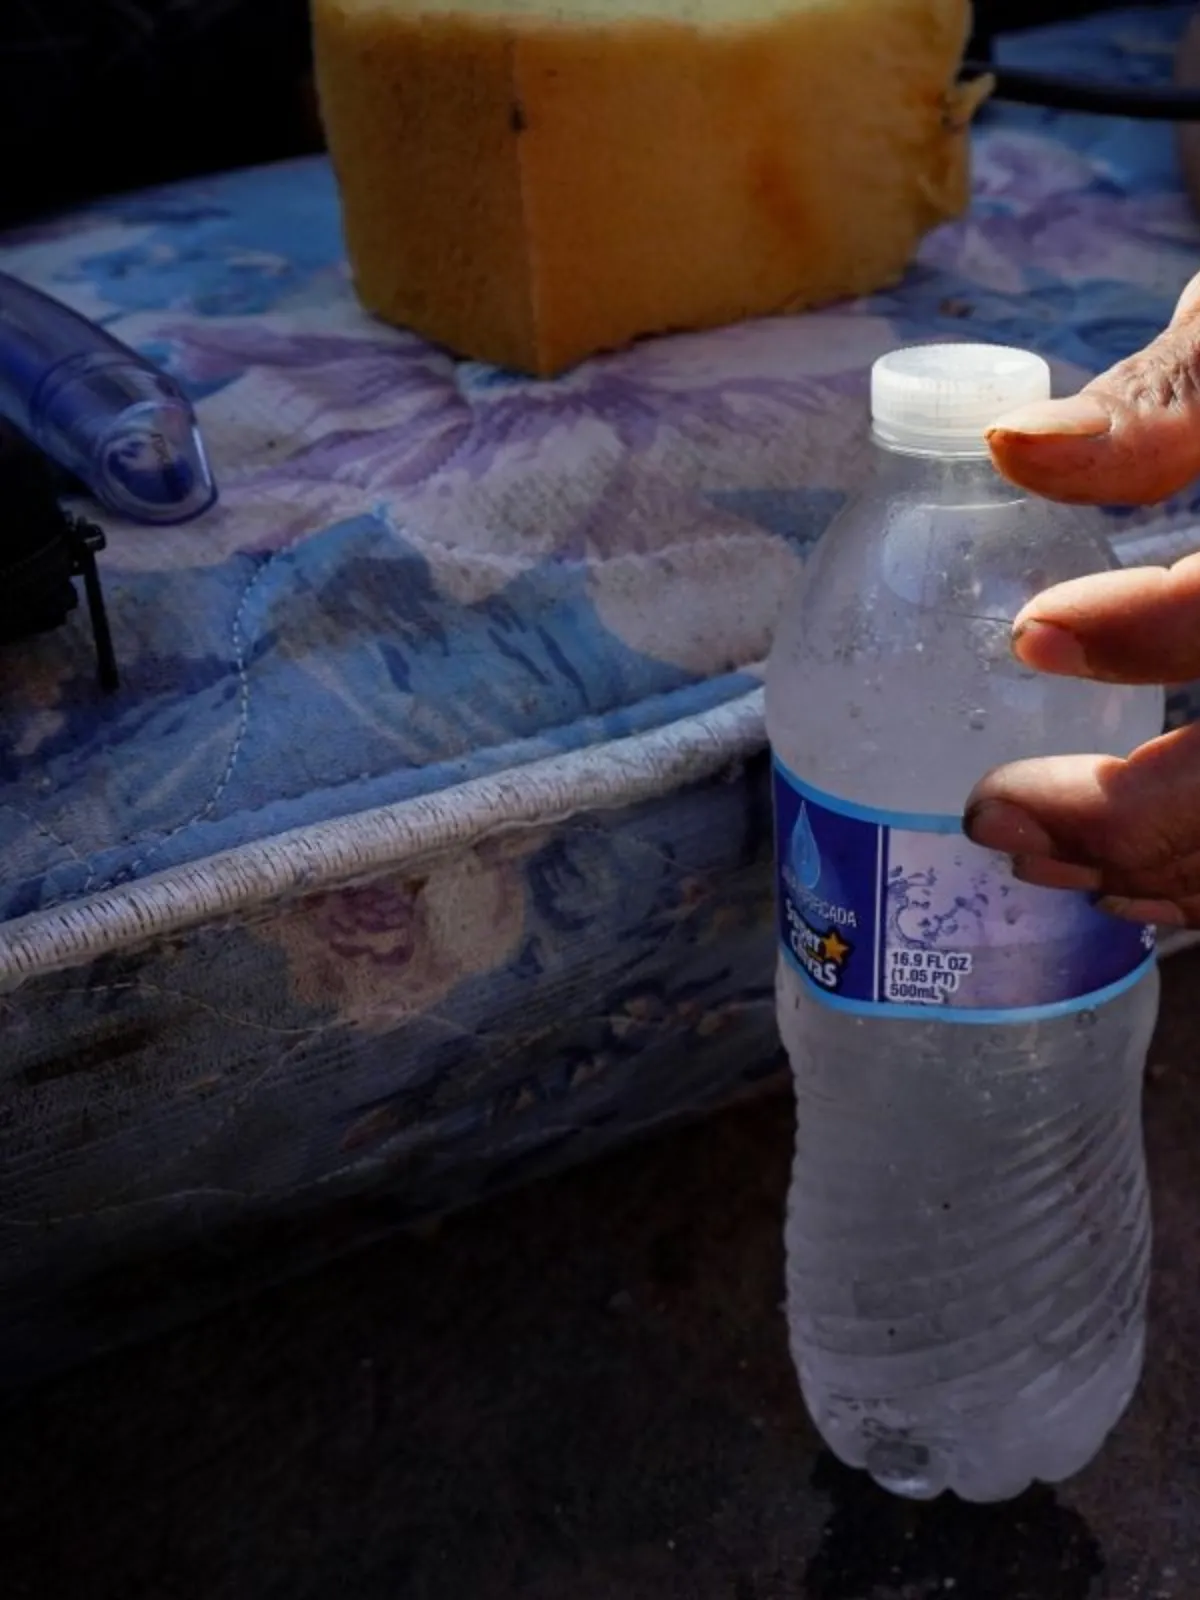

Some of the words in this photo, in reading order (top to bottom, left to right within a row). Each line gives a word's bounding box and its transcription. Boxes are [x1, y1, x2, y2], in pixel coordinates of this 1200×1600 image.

[892, 952, 923, 967] 16.9
[927, 953, 944, 969] FL
[947, 956, 969, 971] OZ
[891, 968, 928, 983] (1.05
[931, 971, 956, 989] PT)
[890, 984, 938, 1000] 500mL
